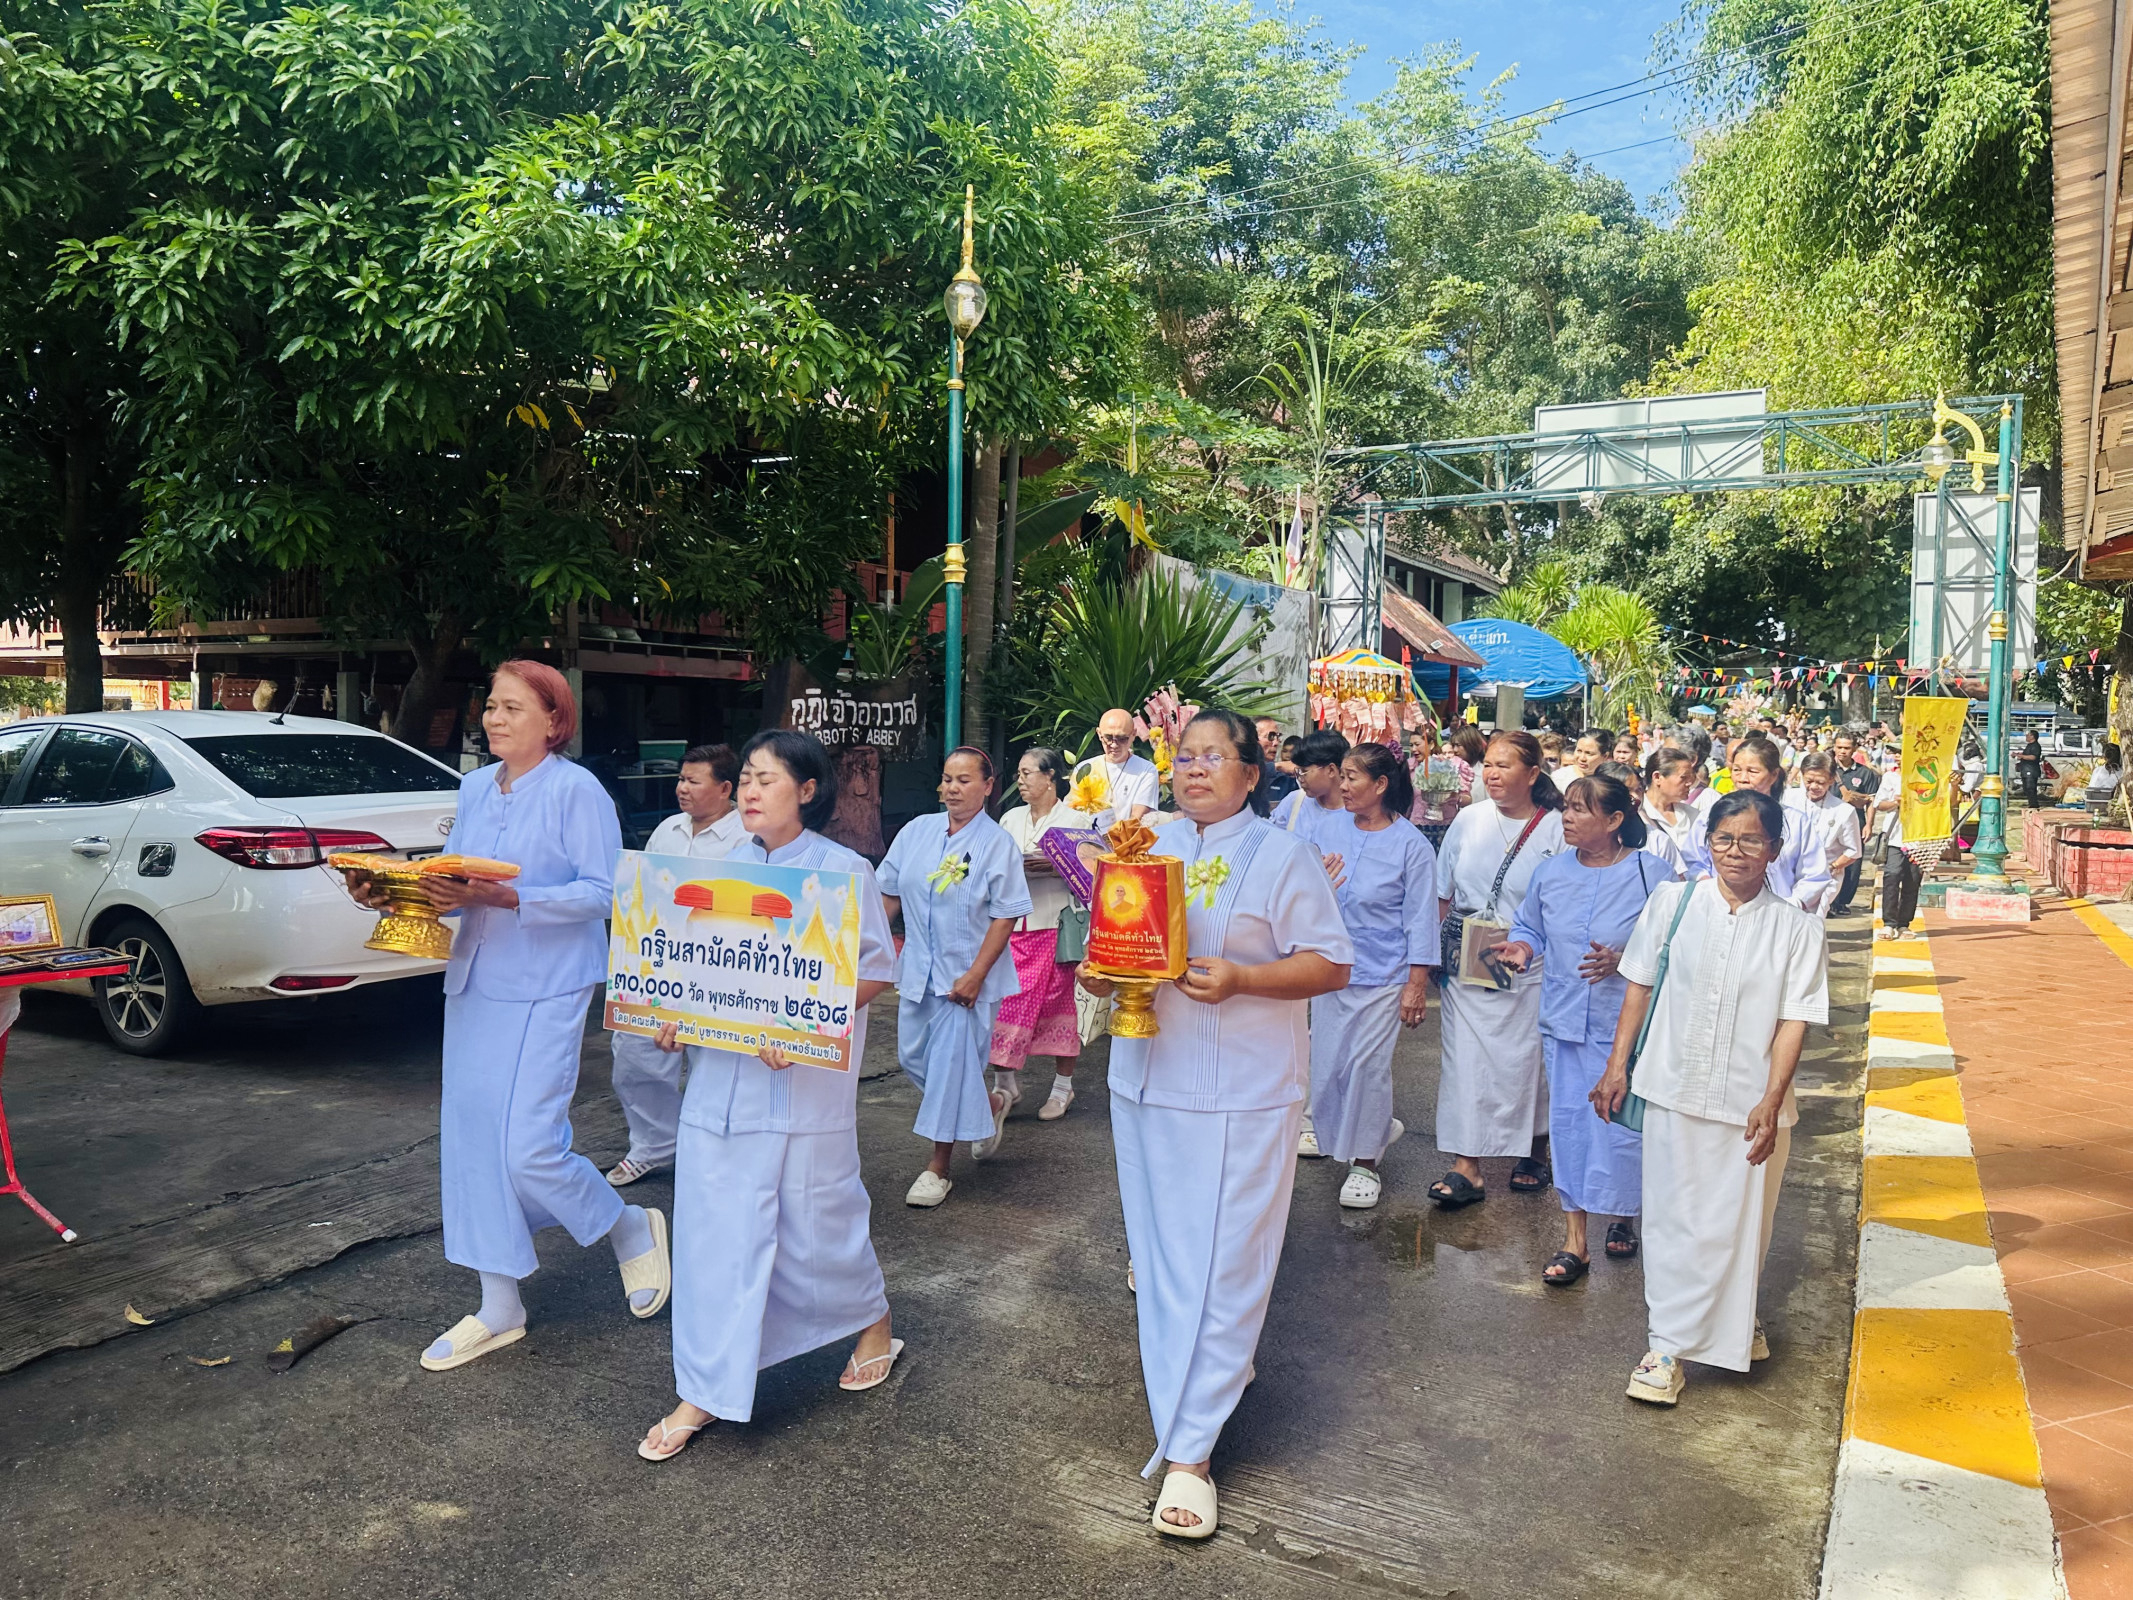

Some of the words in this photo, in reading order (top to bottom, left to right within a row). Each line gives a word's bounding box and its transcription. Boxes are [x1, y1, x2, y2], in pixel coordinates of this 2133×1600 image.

[809, 726, 860, 746] BBOT'S
[866, 729, 901, 746] ABBEY
[641, 928, 822, 982] กฐินสามัคคีทั่วไทย
[614, 972, 683, 999] ๓๐,๐๐๐
[688, 982, 704, 1003] วัด
[708, 990, 779, 1014] พุทธศักราช
[785, 995, 848, 1025] ๒๕๖๘
[614, 1008, 628, 1022] โดย
[631, 1016, 696, 1035] คณะศิษศิษย์
[699, 1027, 740, 1042] บูชาธรรม
[760, 1033, 766, 1046] ปี
